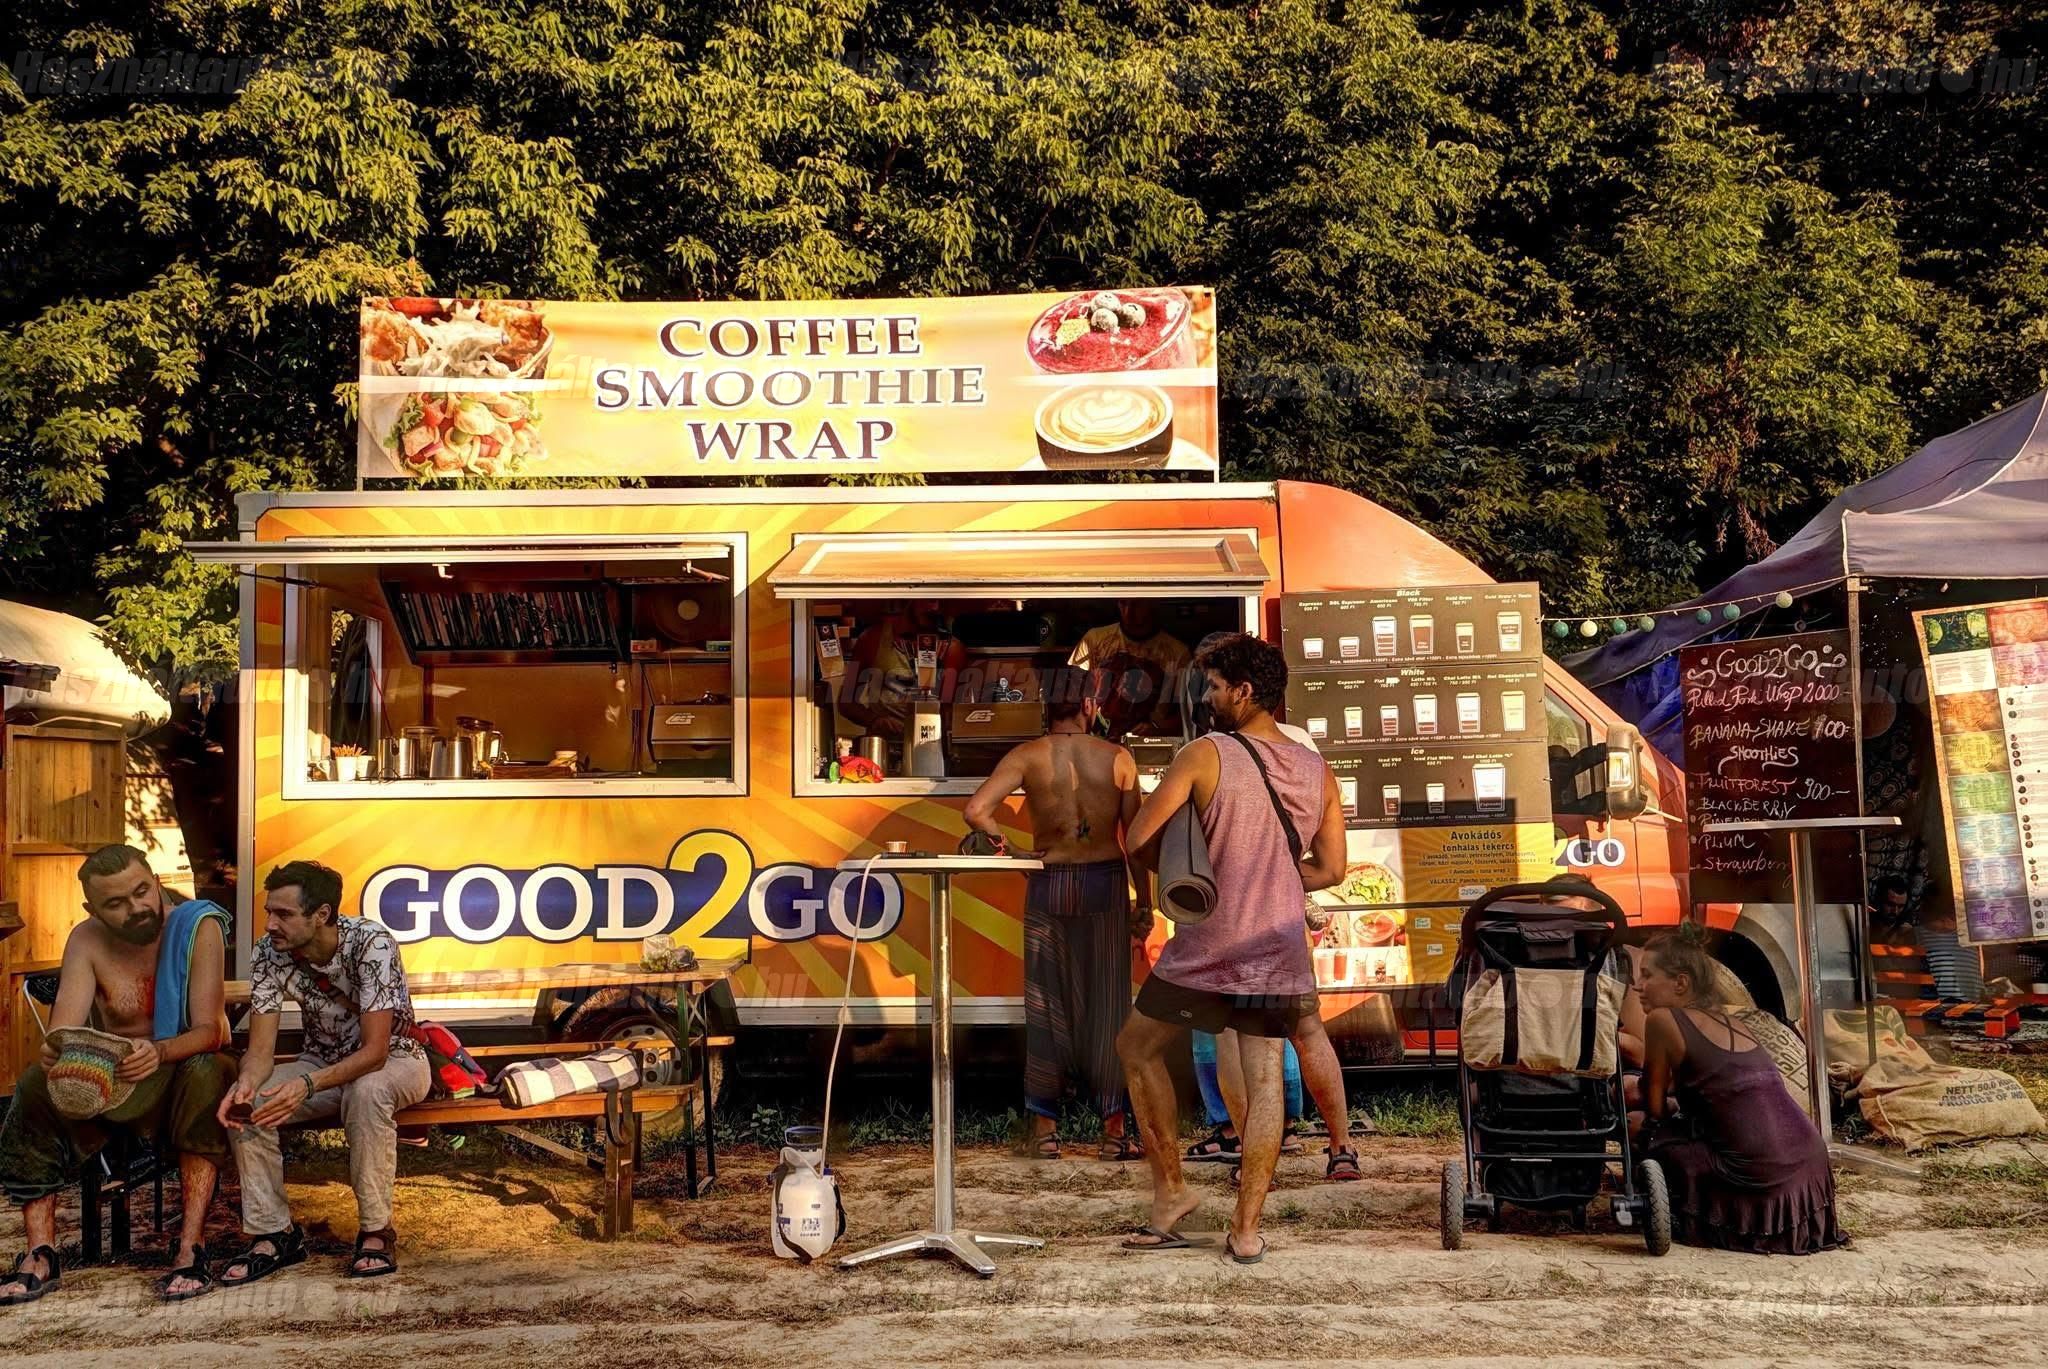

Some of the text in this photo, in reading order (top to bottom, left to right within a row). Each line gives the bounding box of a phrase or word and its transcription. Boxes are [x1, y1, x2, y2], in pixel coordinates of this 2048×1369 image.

[659, 316, 922, 357] COFFEE
[595, 367, 986, 412] SMOOTHIE
[688, 419, 895, 464] WRAP
[1450, 830, 1502, 840] Avokádós
[362, 828, 903, 964] GOOD2GO
[1946, 1085, 1975, 1095] NETT
